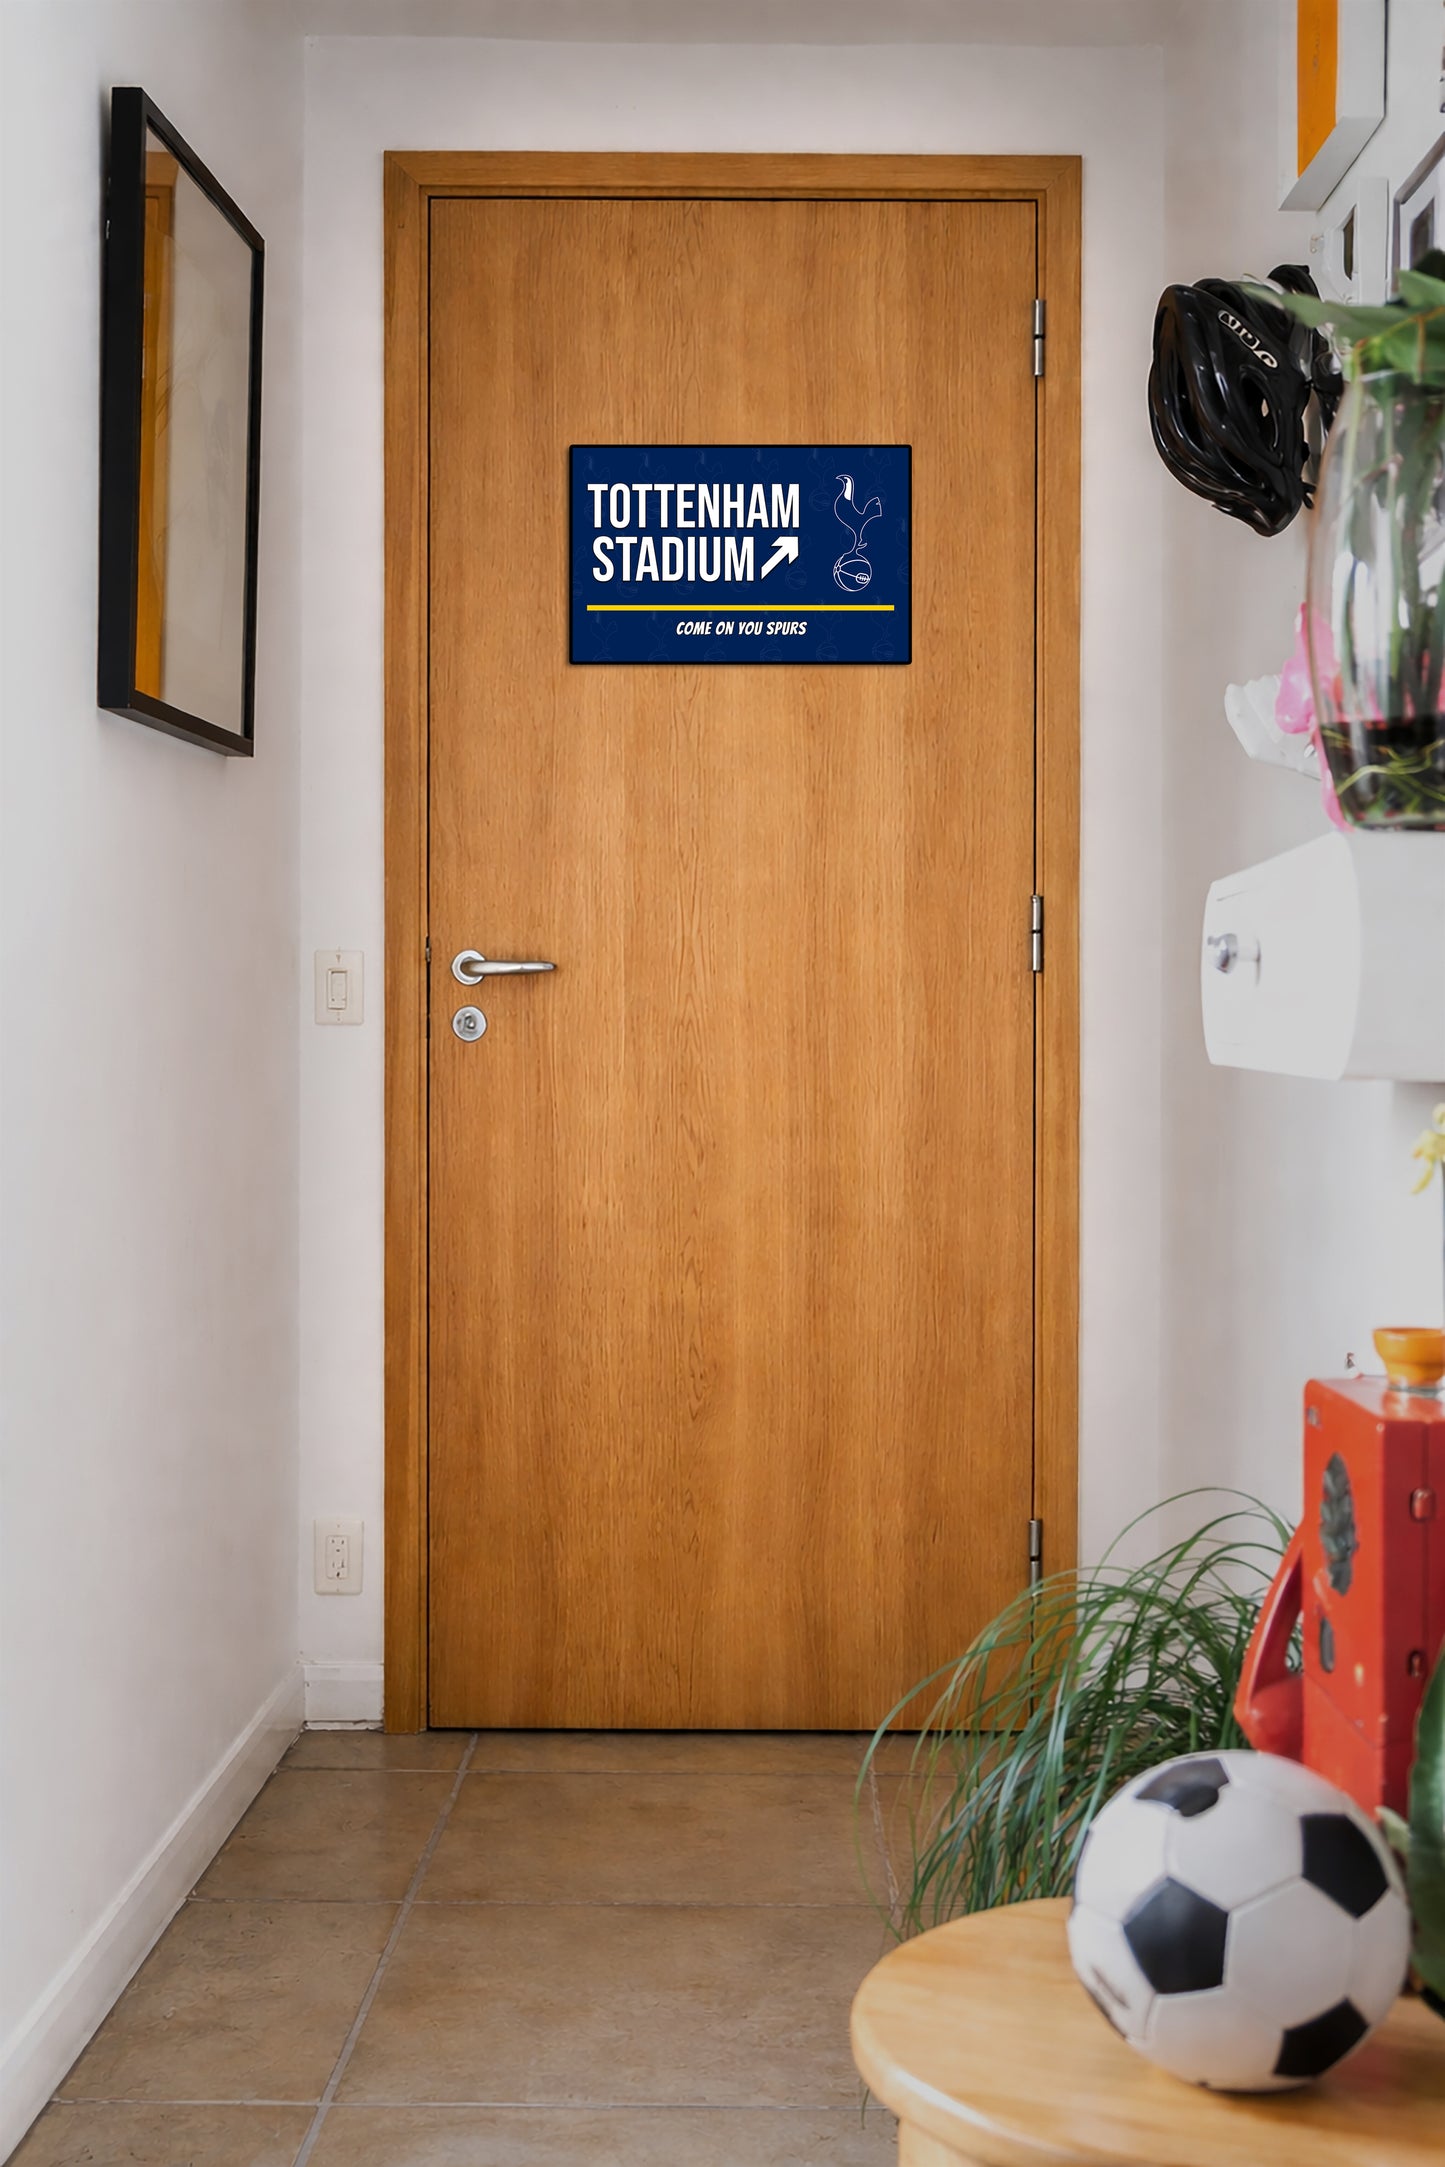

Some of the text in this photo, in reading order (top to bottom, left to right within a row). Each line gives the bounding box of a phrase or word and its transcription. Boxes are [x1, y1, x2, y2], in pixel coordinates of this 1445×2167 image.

[587, 483, 800, 529] TOTTENHAM
[592, 536, 755, 582] STADIUM
[676, 621, 808, 636] COME ON YOU SPURS
